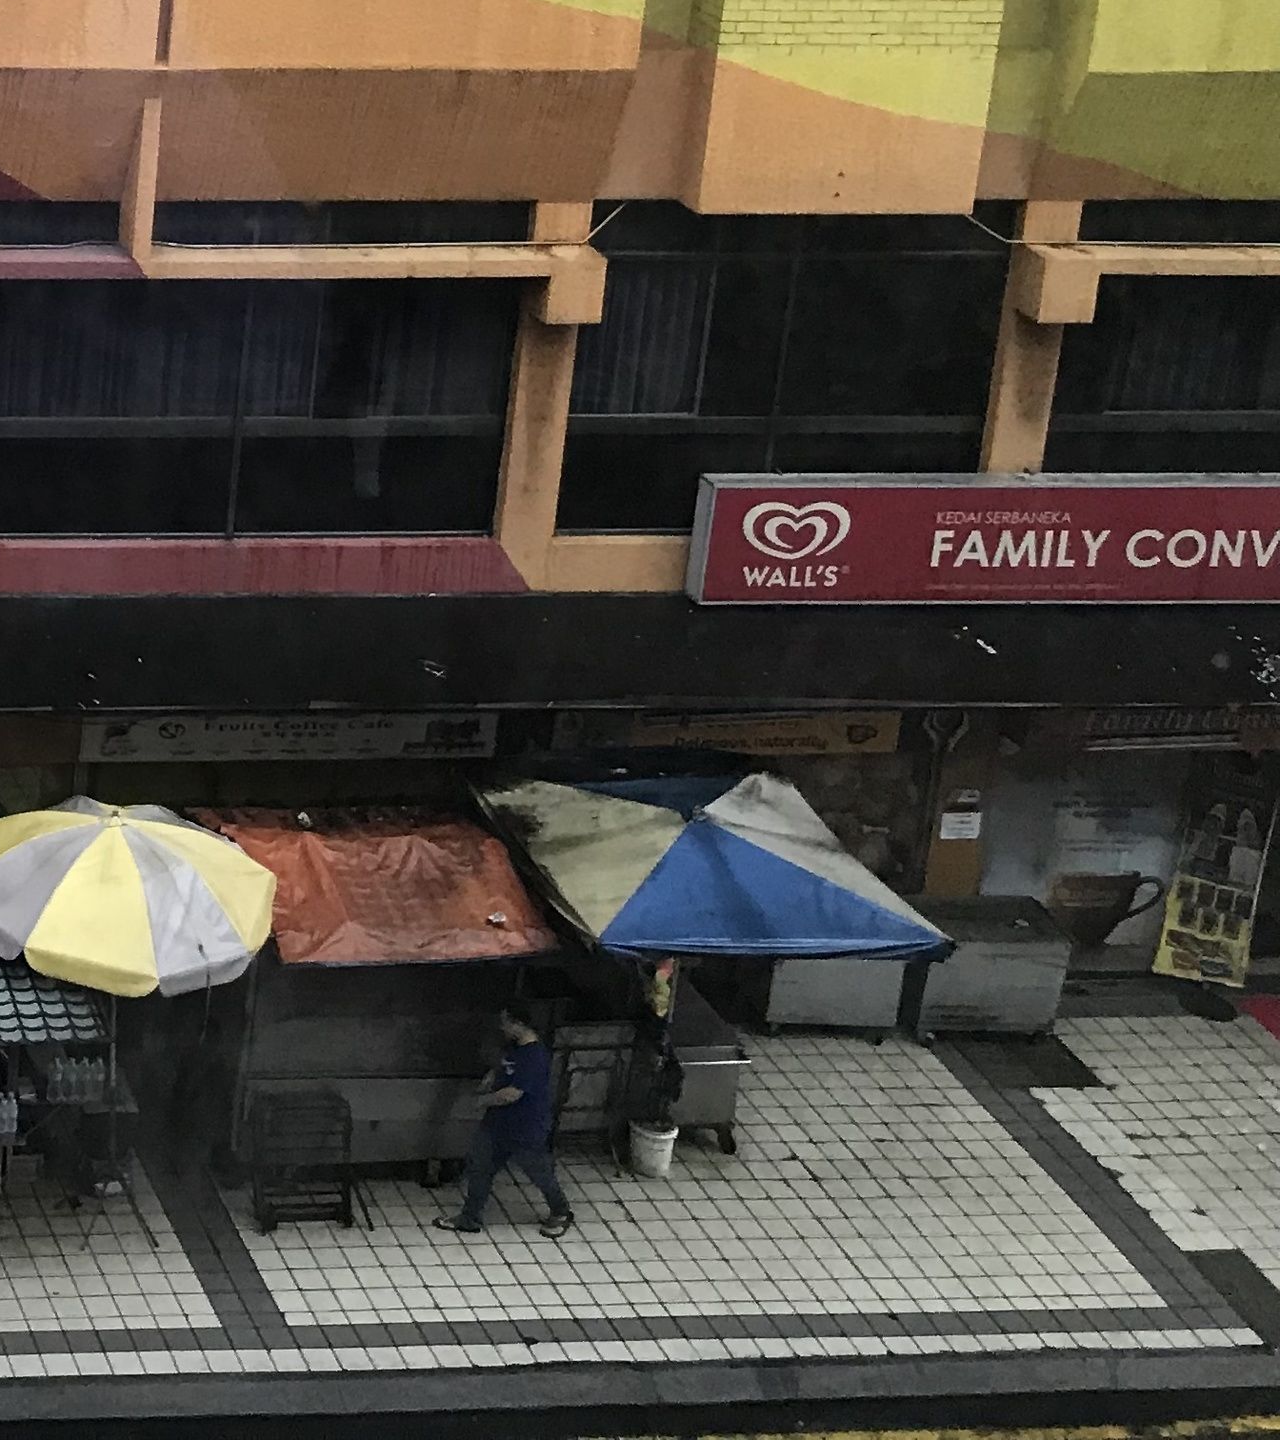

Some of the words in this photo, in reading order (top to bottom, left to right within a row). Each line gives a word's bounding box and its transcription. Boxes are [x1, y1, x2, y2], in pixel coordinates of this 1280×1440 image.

[936, 511, 983, 525] KEDAI
[985, 511, 1072, 525] SERBANEKA
[930, 530, 1112, 567] FAMILY
[1125, 529, 1280, 568] CONV
[743, 565, 838, 587] WALL'S
[273, 720, 339, 731] Coffee
